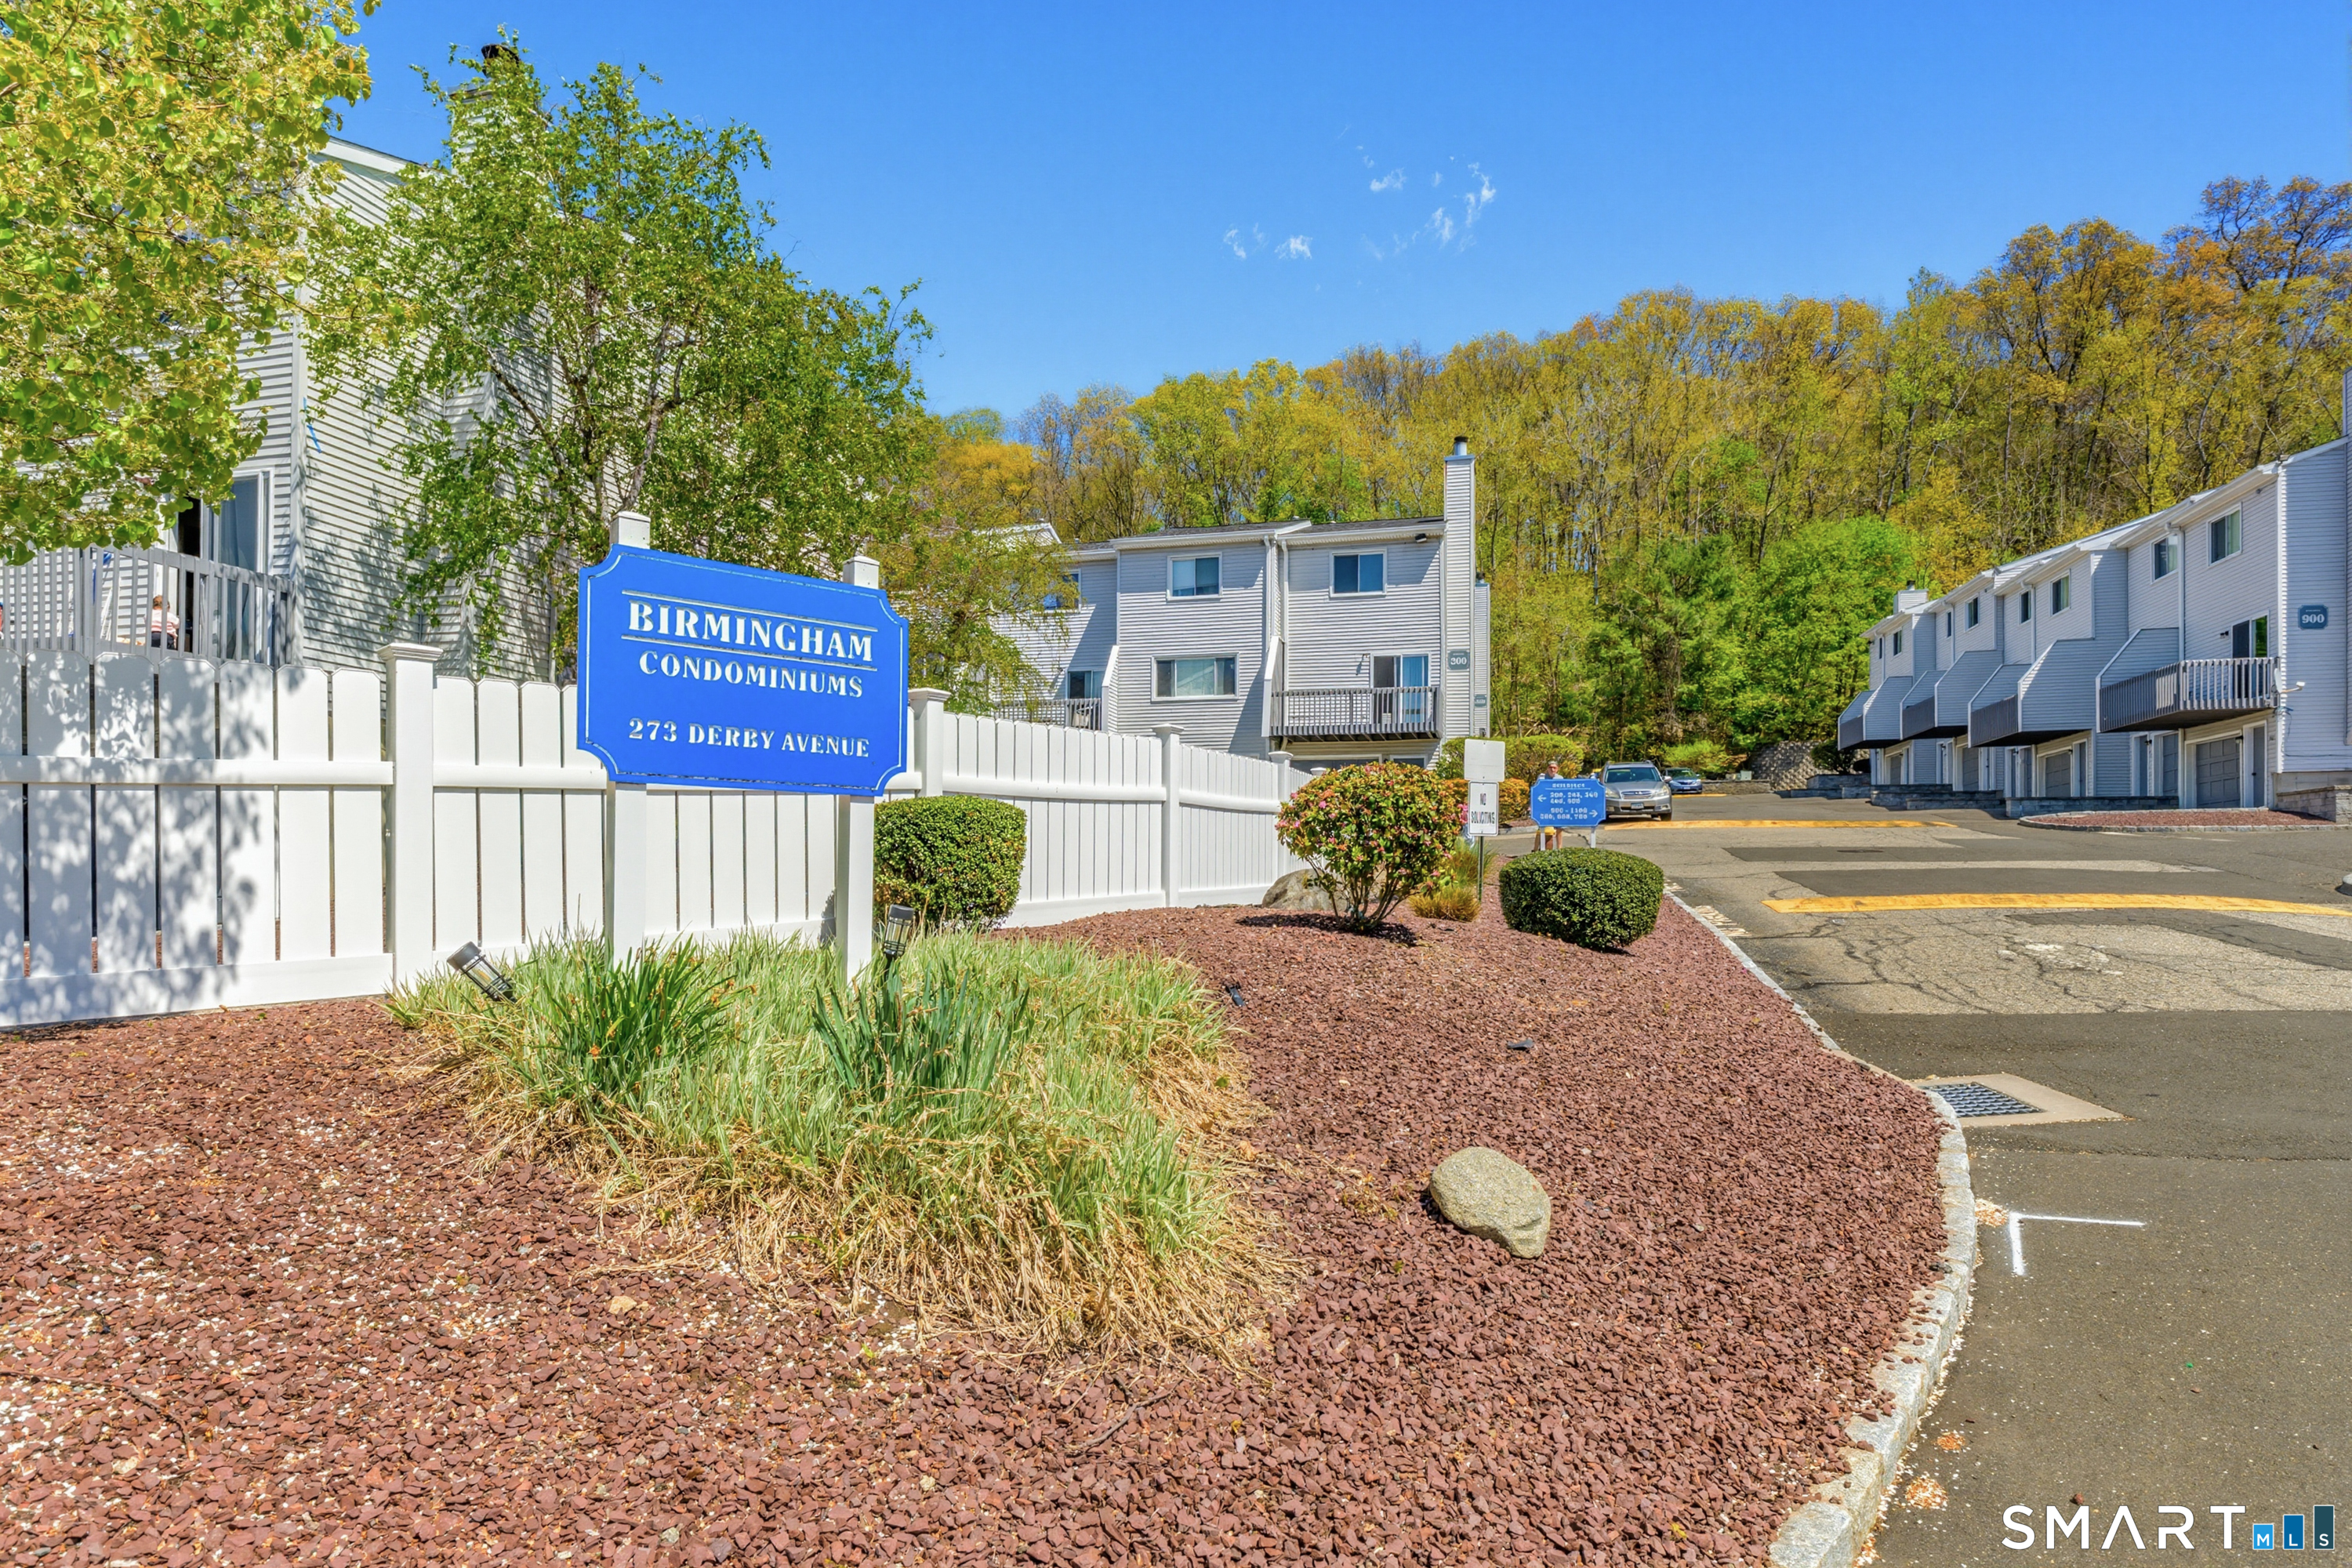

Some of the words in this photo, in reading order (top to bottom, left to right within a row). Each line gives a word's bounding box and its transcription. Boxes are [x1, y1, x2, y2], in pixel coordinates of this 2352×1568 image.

[628, 600, 873, 662] BIRMINGHAM
[2301, 614, 2325, 624] 900
[639, 651, 862, 698] CONDOMINIUMS
[629, 717, 677, 742] 273
[688, 723, 775, 750] DERBY
[782, 732, 869, 758] AVENUE
[1479, 793, 1486, 806] NO
[1471, 811, 1495, 825] SOLICITING
